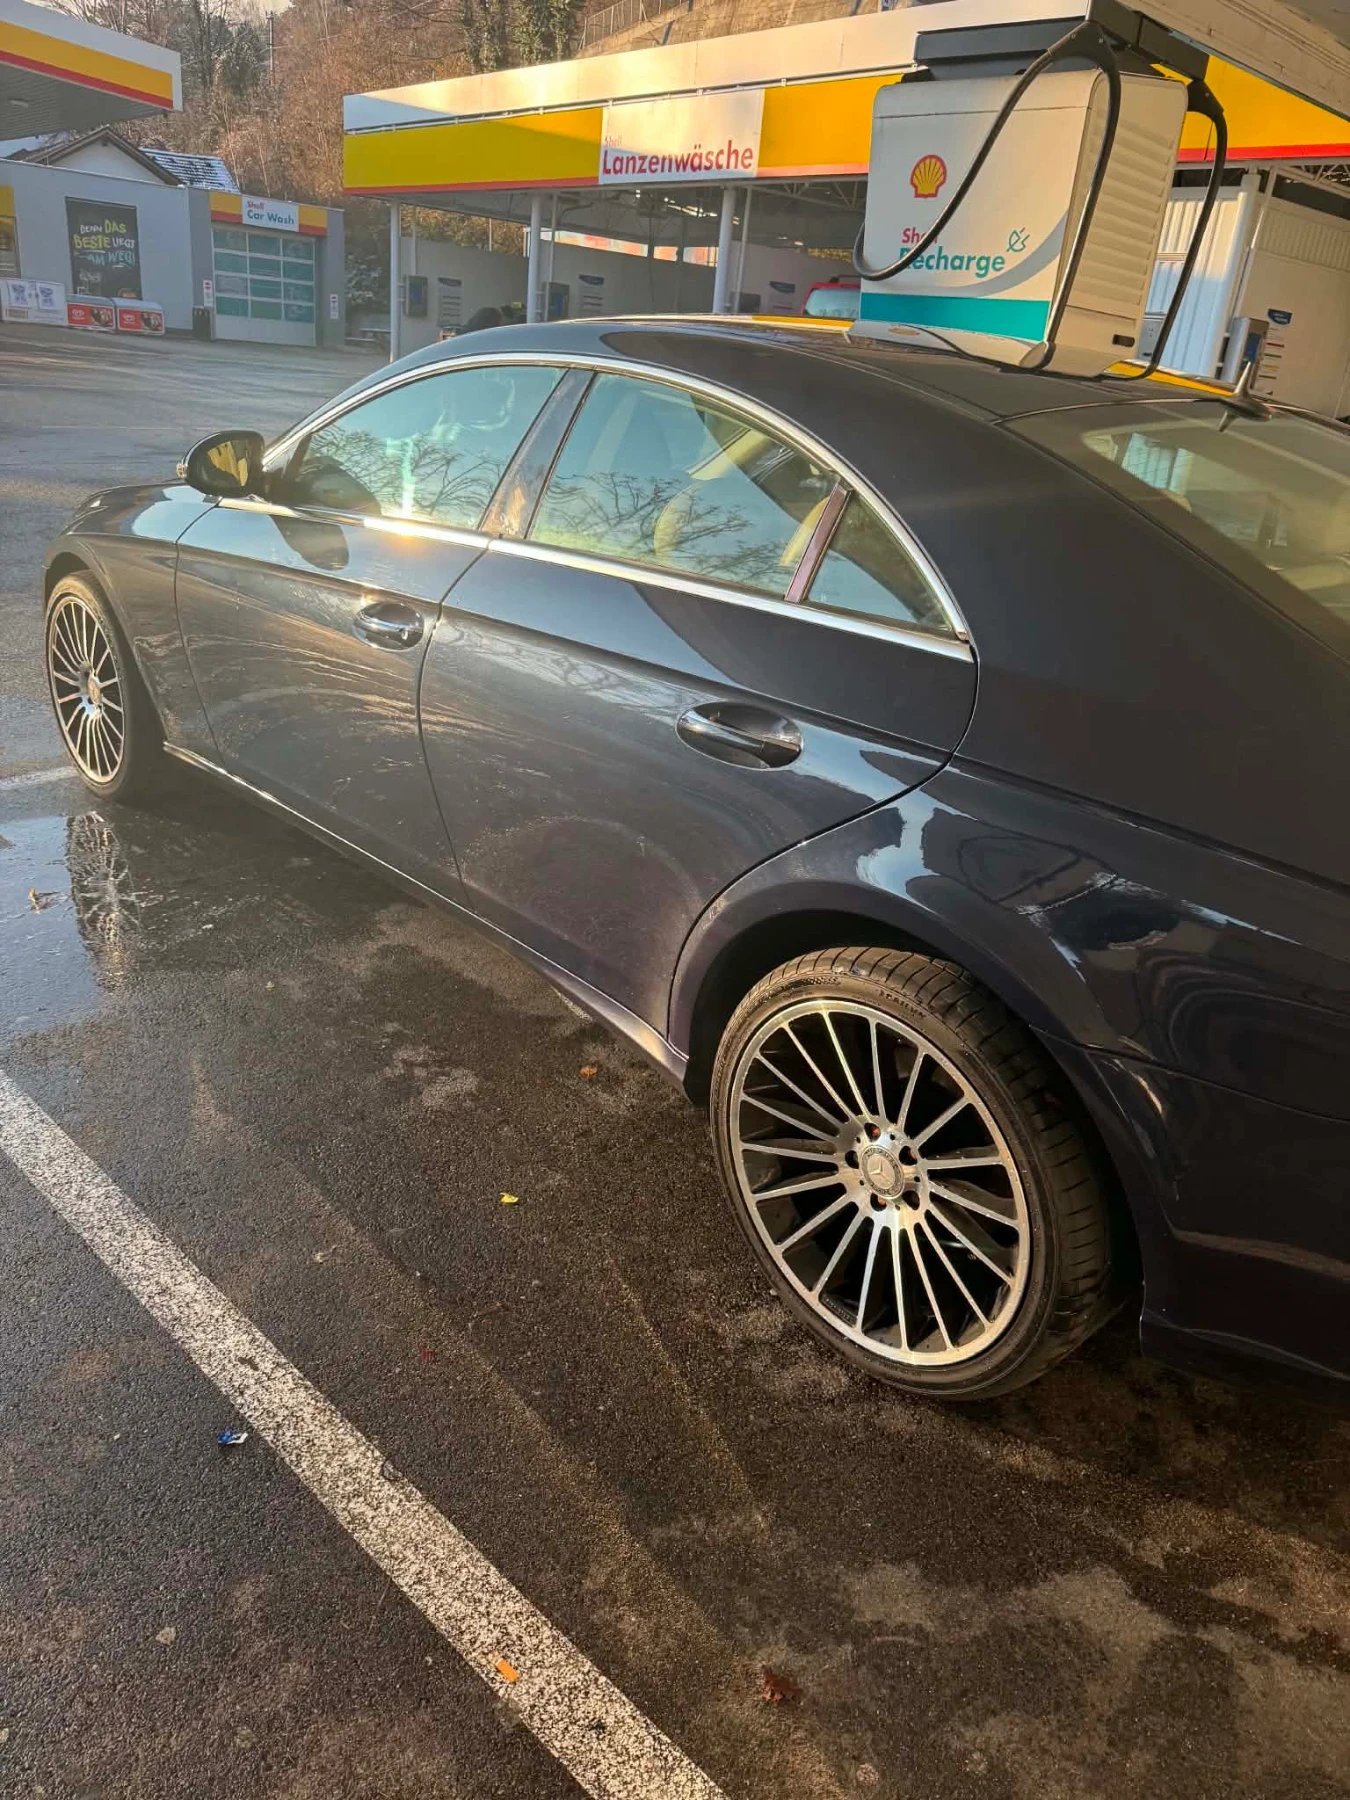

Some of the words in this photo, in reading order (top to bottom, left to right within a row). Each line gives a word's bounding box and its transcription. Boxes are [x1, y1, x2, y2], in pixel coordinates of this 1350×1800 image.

[602, 140, 754, 175] Lanzenwäsche
[247, 209, 265, 220] Car
[267, 211, 295, 225] Wash
[104, 219, 127, 233] DAS
[73, 234, 111, 249] BESTE
